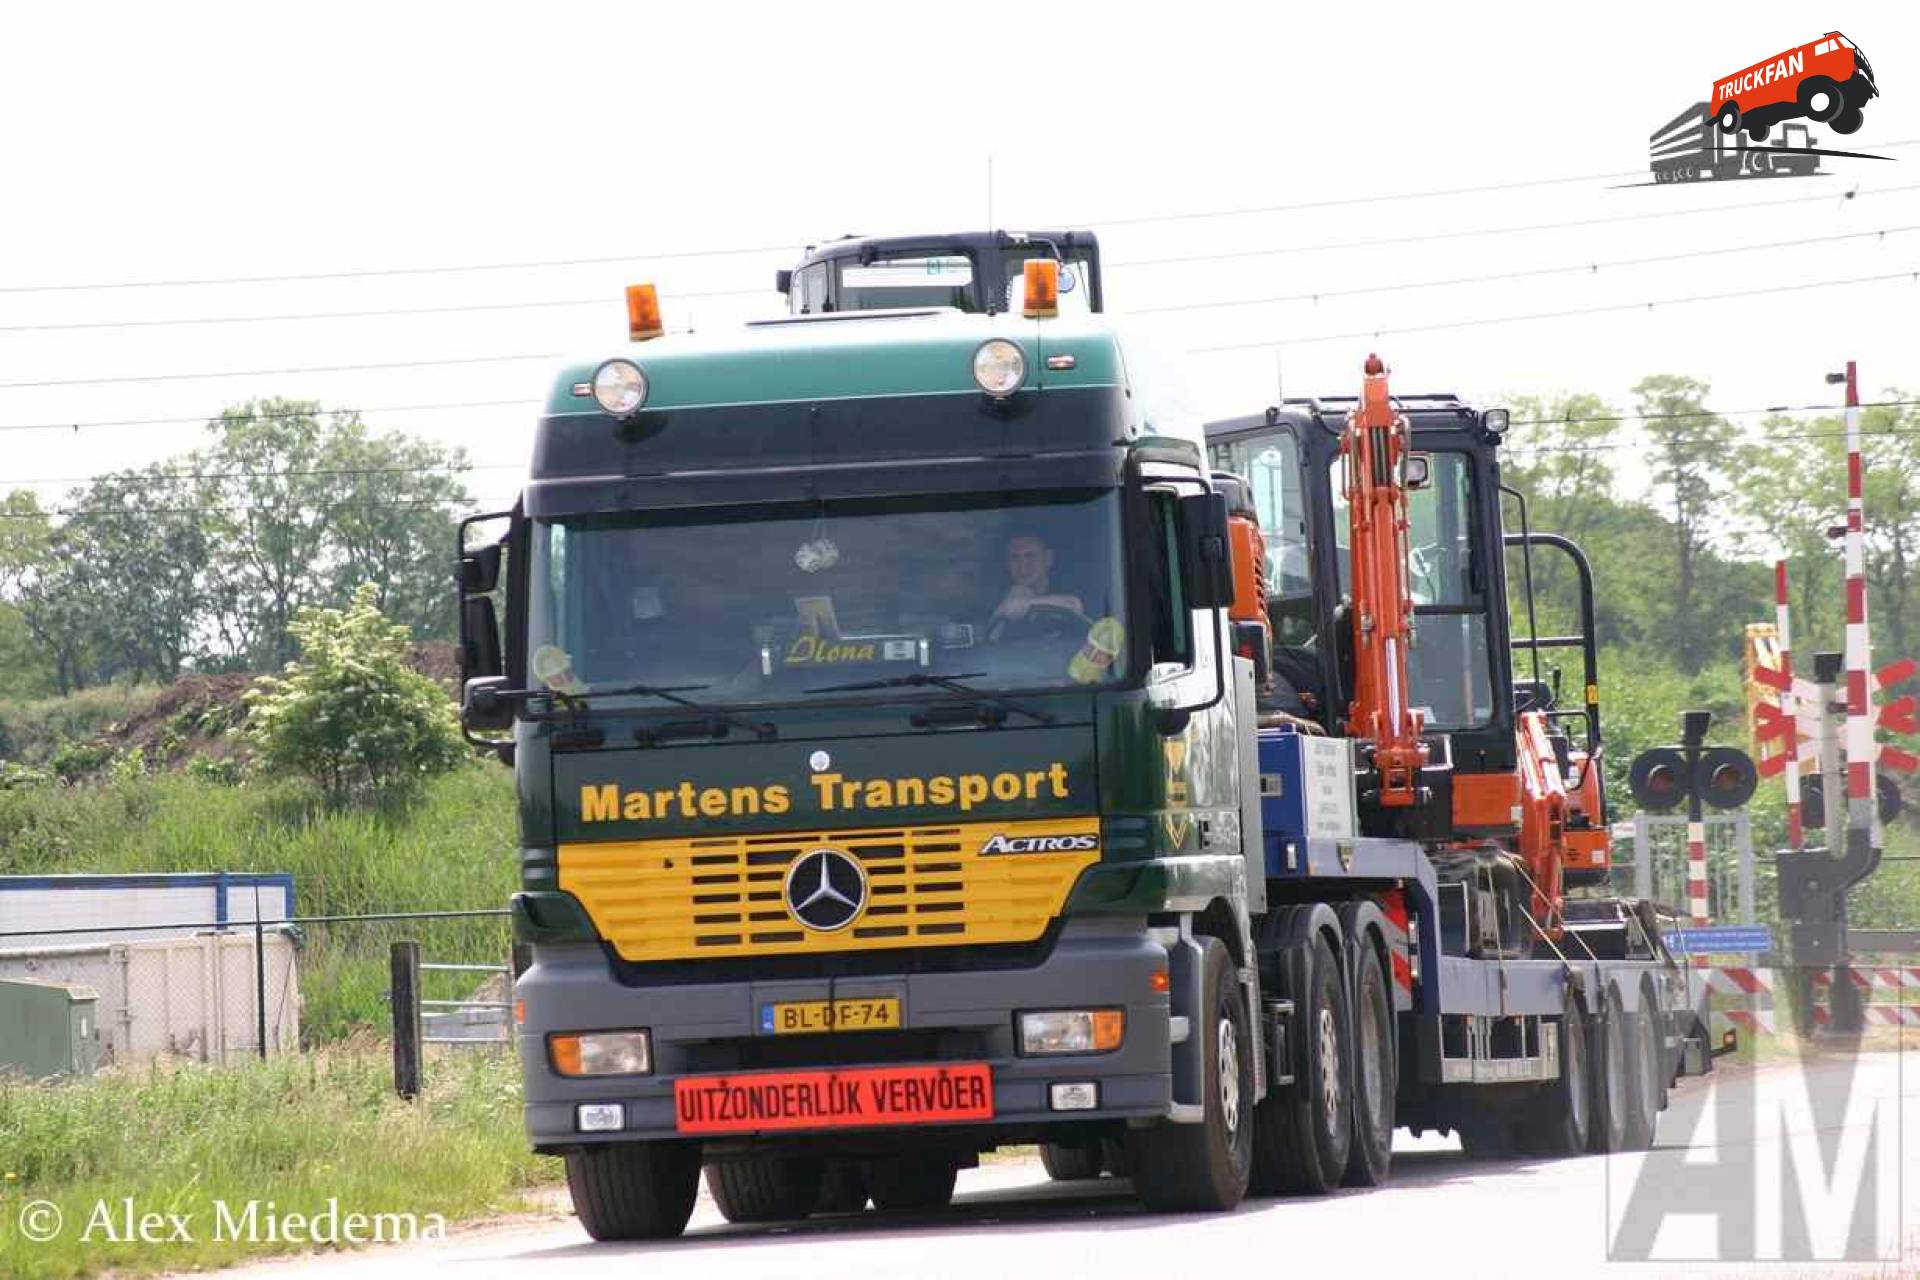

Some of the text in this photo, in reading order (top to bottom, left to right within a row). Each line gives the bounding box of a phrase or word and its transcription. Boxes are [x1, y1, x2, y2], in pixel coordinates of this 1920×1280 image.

[581, 763, 1068, 822] Martens Transport
[784, 1004, 890, 1029] BL-DF-74
[680, 1074, 986, 1122] UITZONDERLIJK VERVOER
